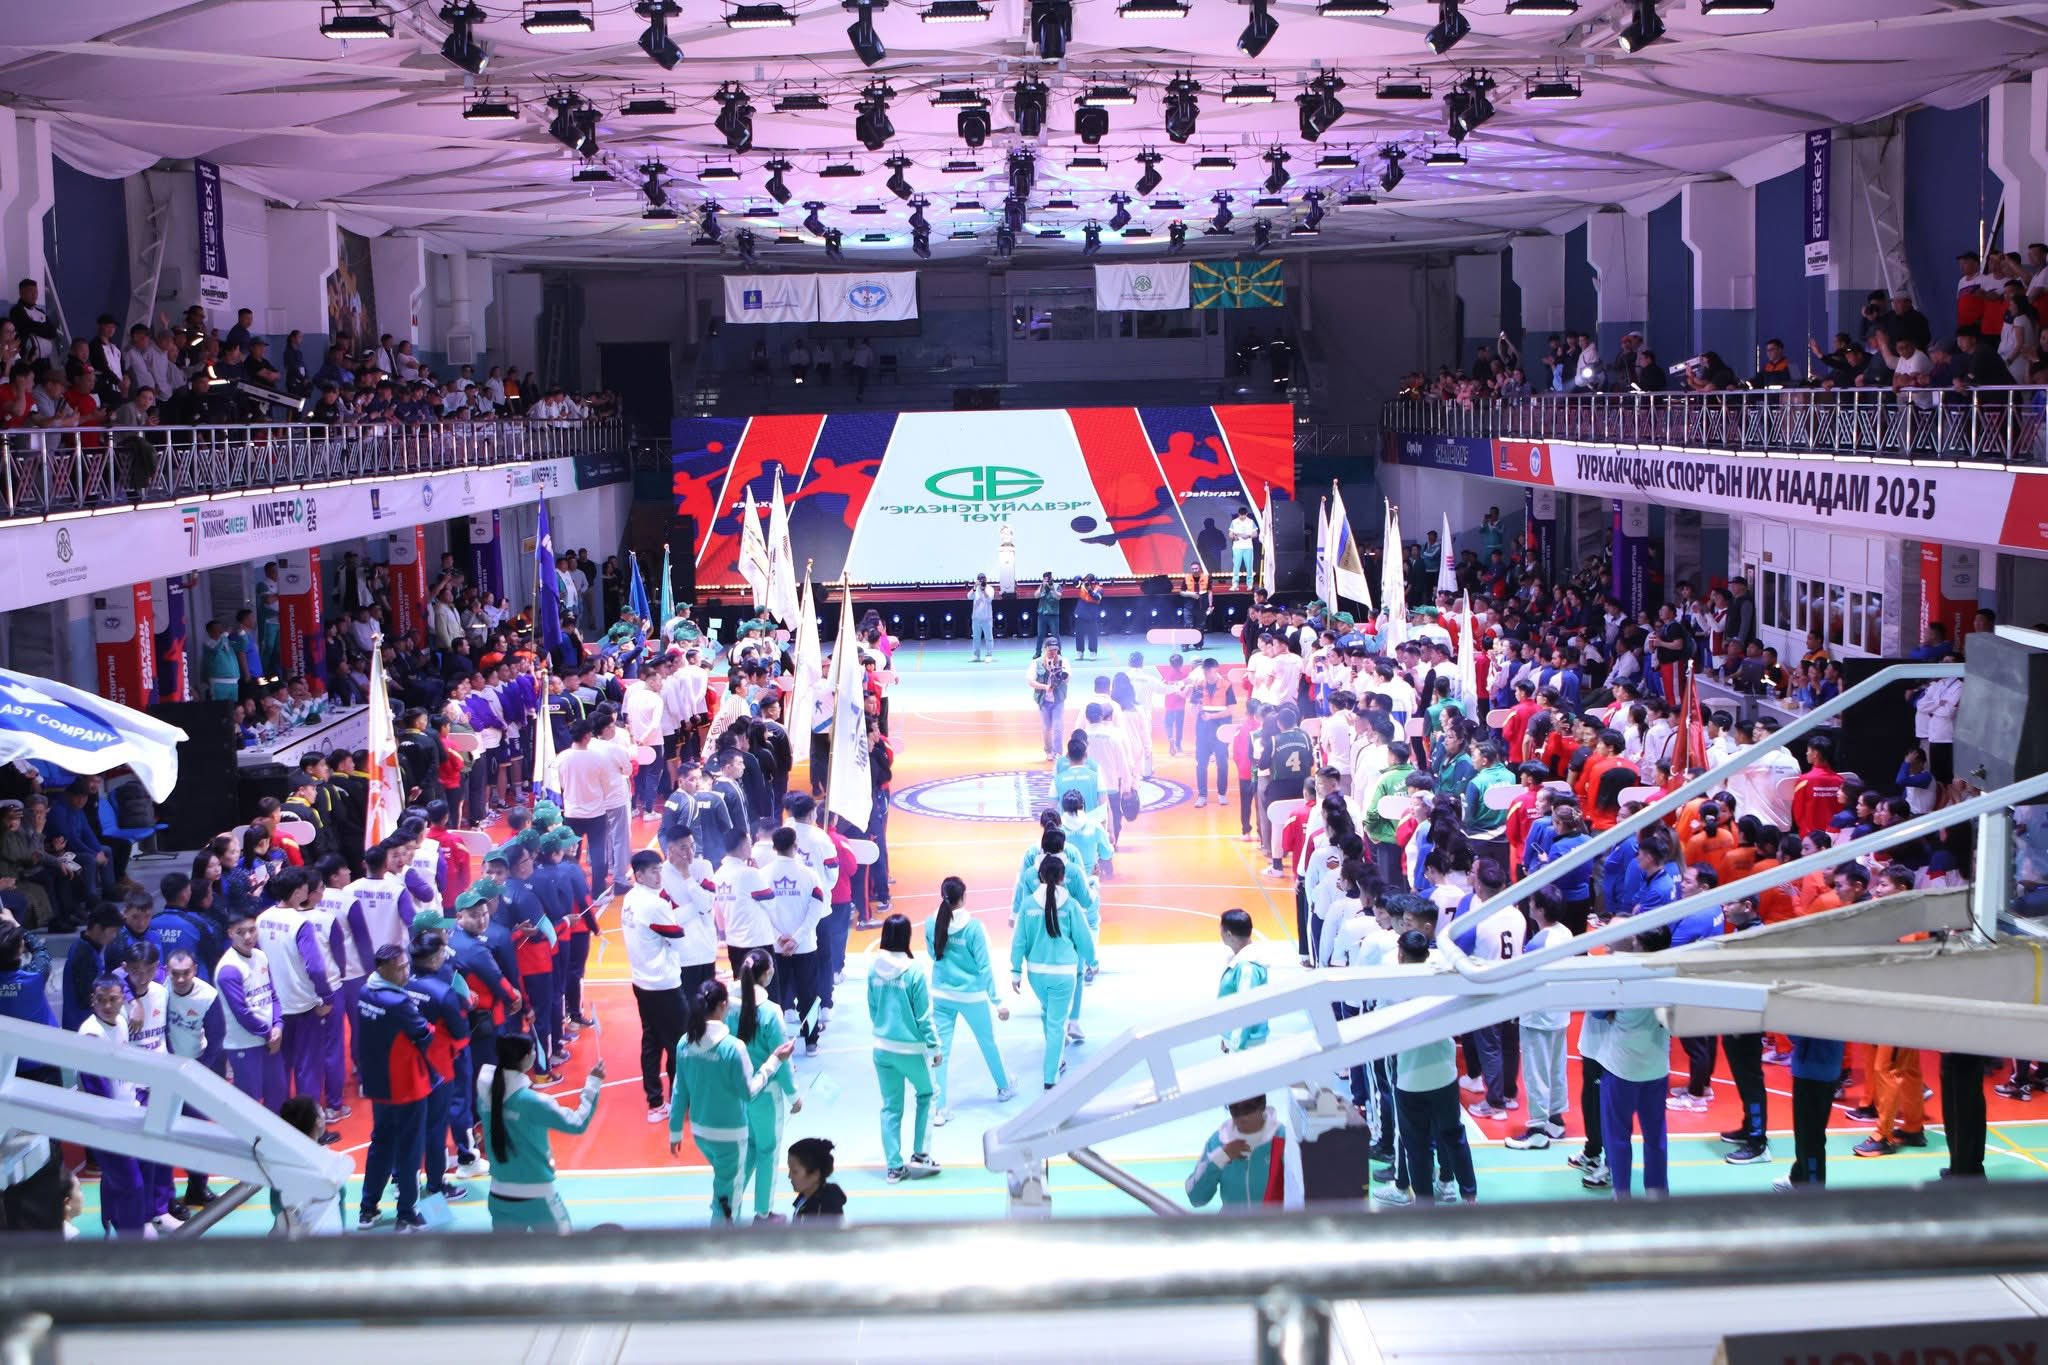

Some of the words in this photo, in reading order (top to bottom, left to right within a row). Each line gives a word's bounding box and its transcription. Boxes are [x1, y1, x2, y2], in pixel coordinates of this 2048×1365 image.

[1576, 451, 1664, 490] УУРХАЙЧДЫН
[1667, 463, 1742, 498] СПОРТЫН
[1750, 466, 1773, 501] ИХ
[1776, 469, 1870, 516] НААДАМ
[1875, 476, 1937, 520] 2025
[306, 498, 317, 514] 20
[307, 515, 317, 532] 25
[36, 714, 119, 742] COMPANY
[1286, 751, 1301, 771] 4
[1445, 907, 1457, 921] 7
[1501, 931, 1512, 959] 6
